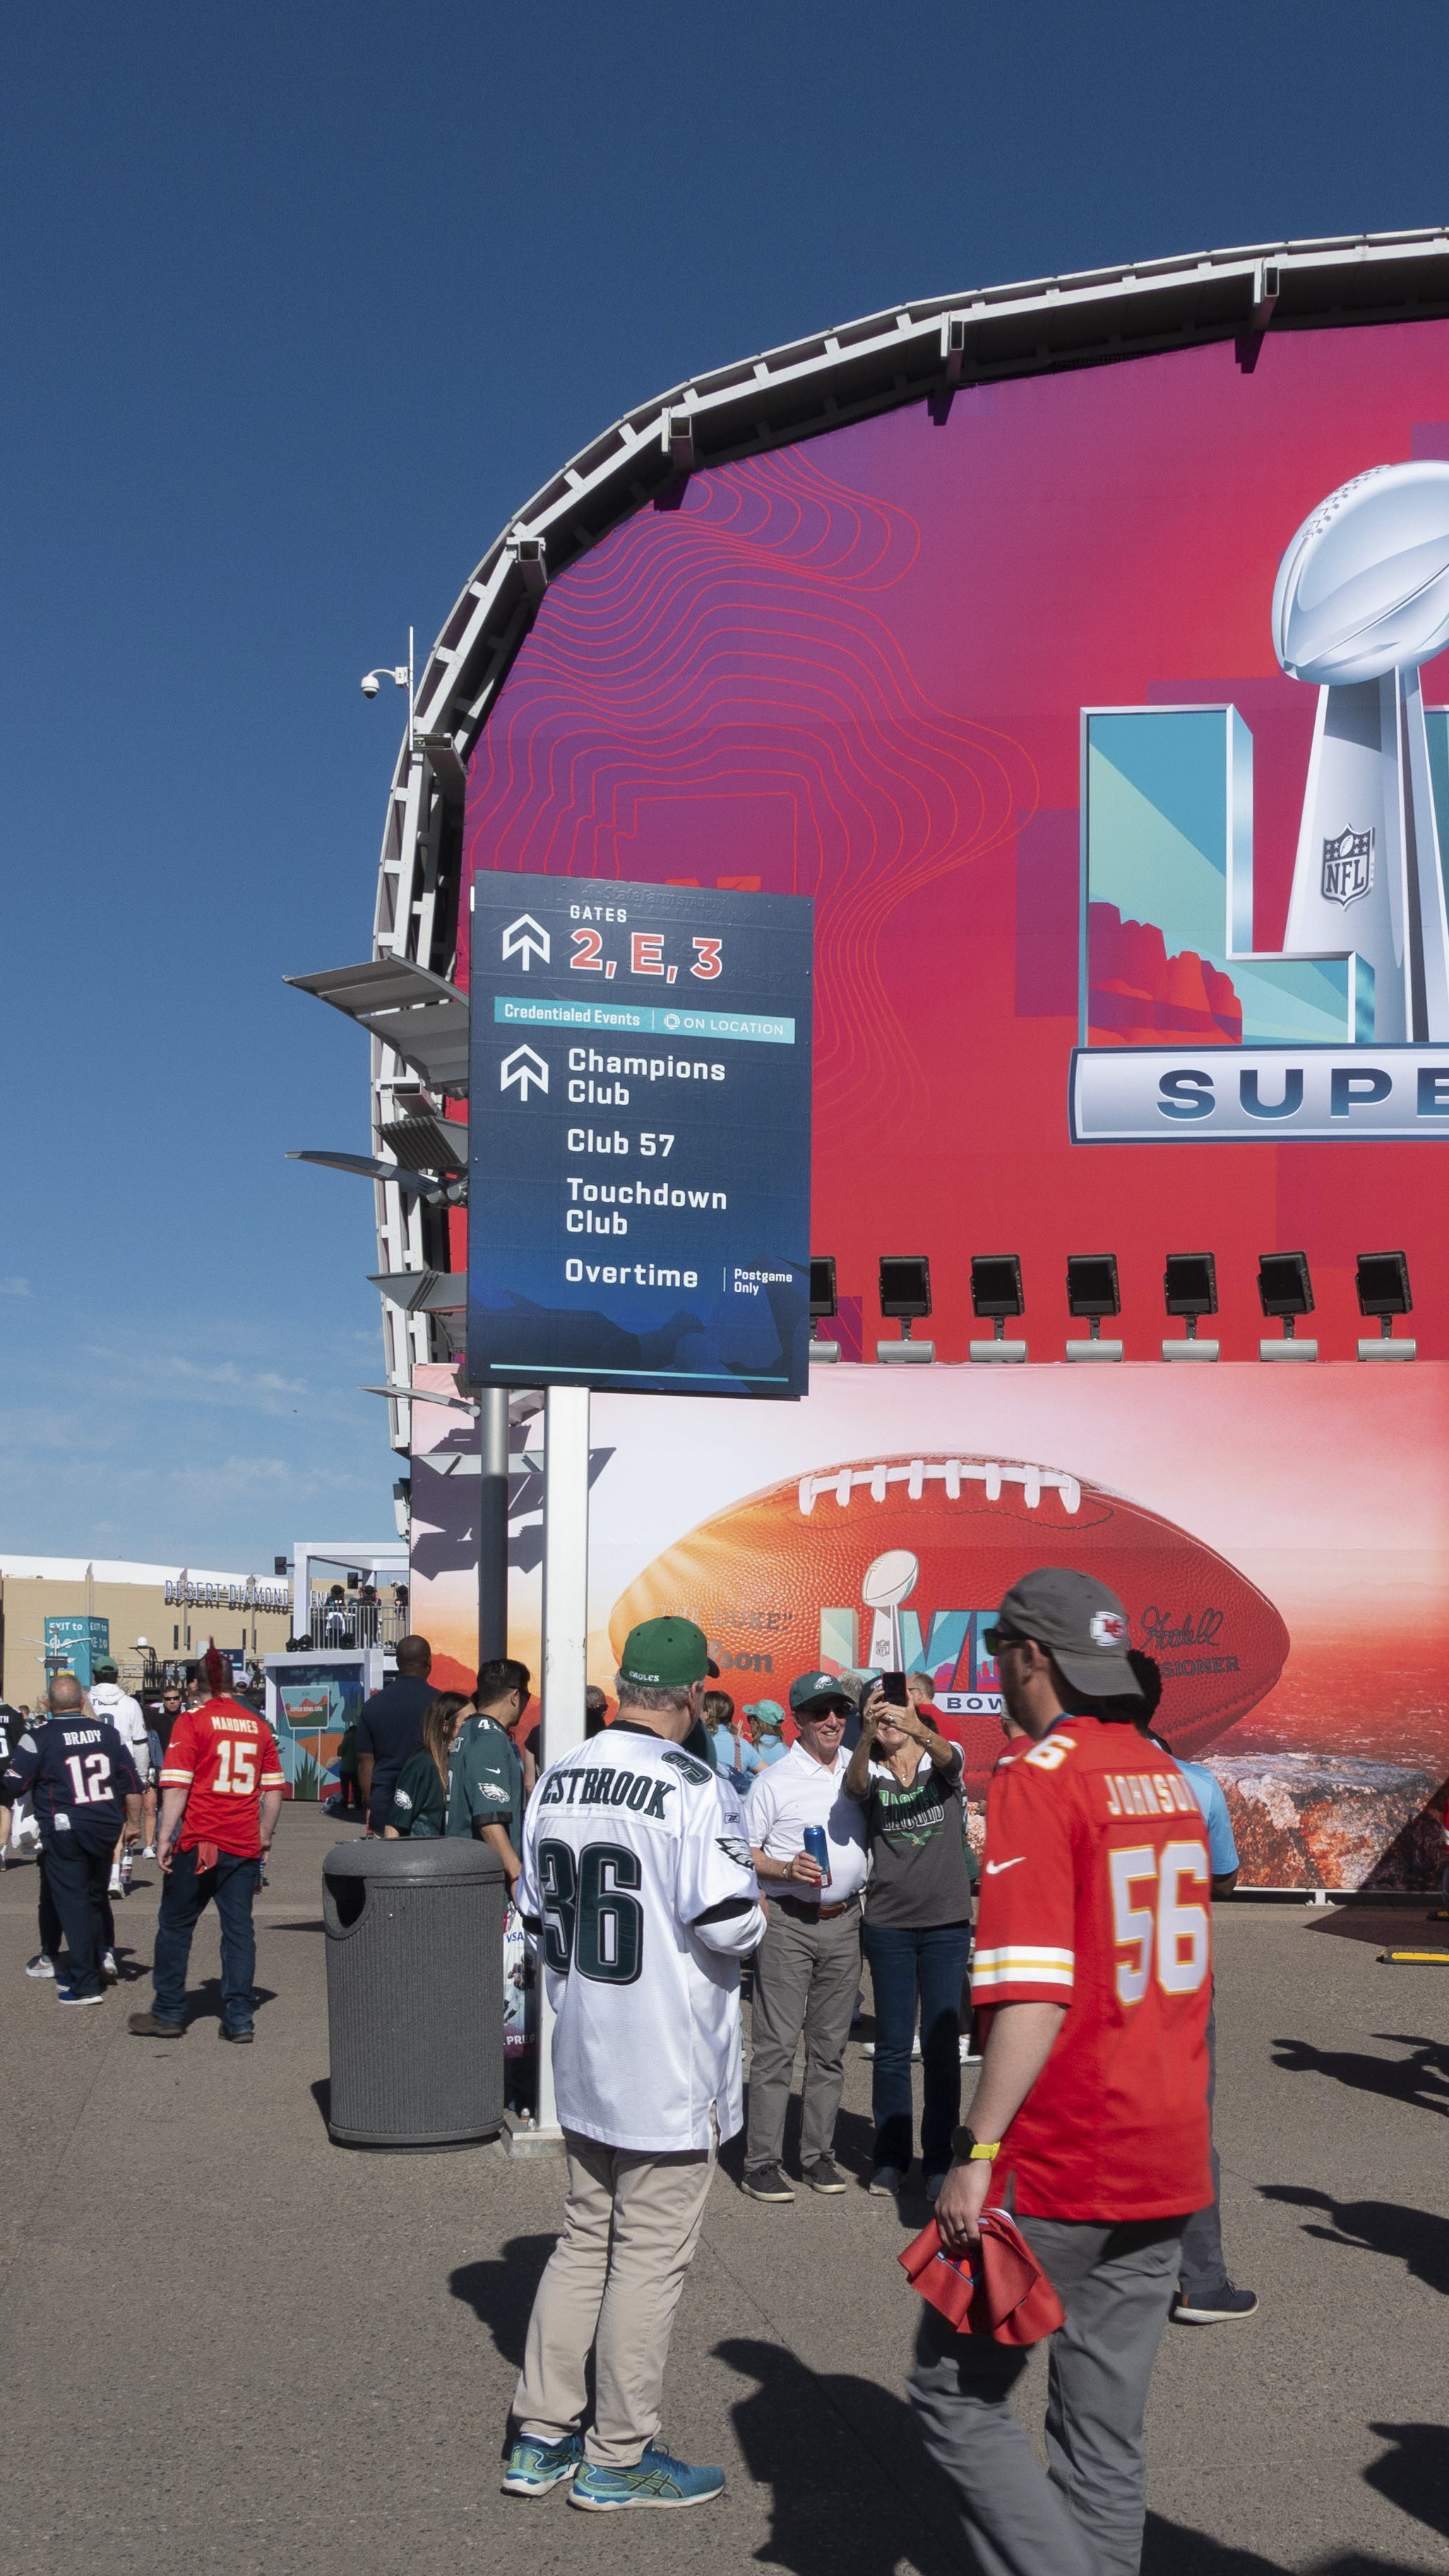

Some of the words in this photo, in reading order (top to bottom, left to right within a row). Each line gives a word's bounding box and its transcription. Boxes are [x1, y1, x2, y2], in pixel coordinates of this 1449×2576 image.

[1325, 859, 1365, 895] NFL
[571, 905, 627, 923] GATES
[570, 928, 617, 979] 2,
[631, 932, 678, 984] E,
[690, 937, 722, 979] 3
[504, 1003, 590, 1022] Credentialed
[595, 1010, 640, 1027] Events
[684, 1018, 705, 1029] ON
[710, 1021, 784, 1035] LOCATION
[568, 1048, 726, 1082] Champions
[568, 1080, 630, 1107] Club
[567, 1128, 629, 1156] Club
[639, 1133, 674, 1158] 57
[567, 1179, 727, 1210] Touchdown
[566, 1210, 628, 1235] Club
[565, 1258, 698, 1288] Overtime
[734, 1268, 793, 1284] Postgame
[734, 1282, 760, 1296] Only
[165, 1580, 221, 1601] DESERT
[228, 1582, 290, 1606] DIAMOND
[628, 1670, 660, 1683] EAGLES
[62, 1730, 102, 1746] BRADY
[211, 1716, 259, 1734] MAHOMES
[65, 1753, 114, 1804] 12
[213, 1739, 258, 1794] 15
[538, 1838, 644, 1986] 36
[1108, 1839, 1209, 2005] 56
